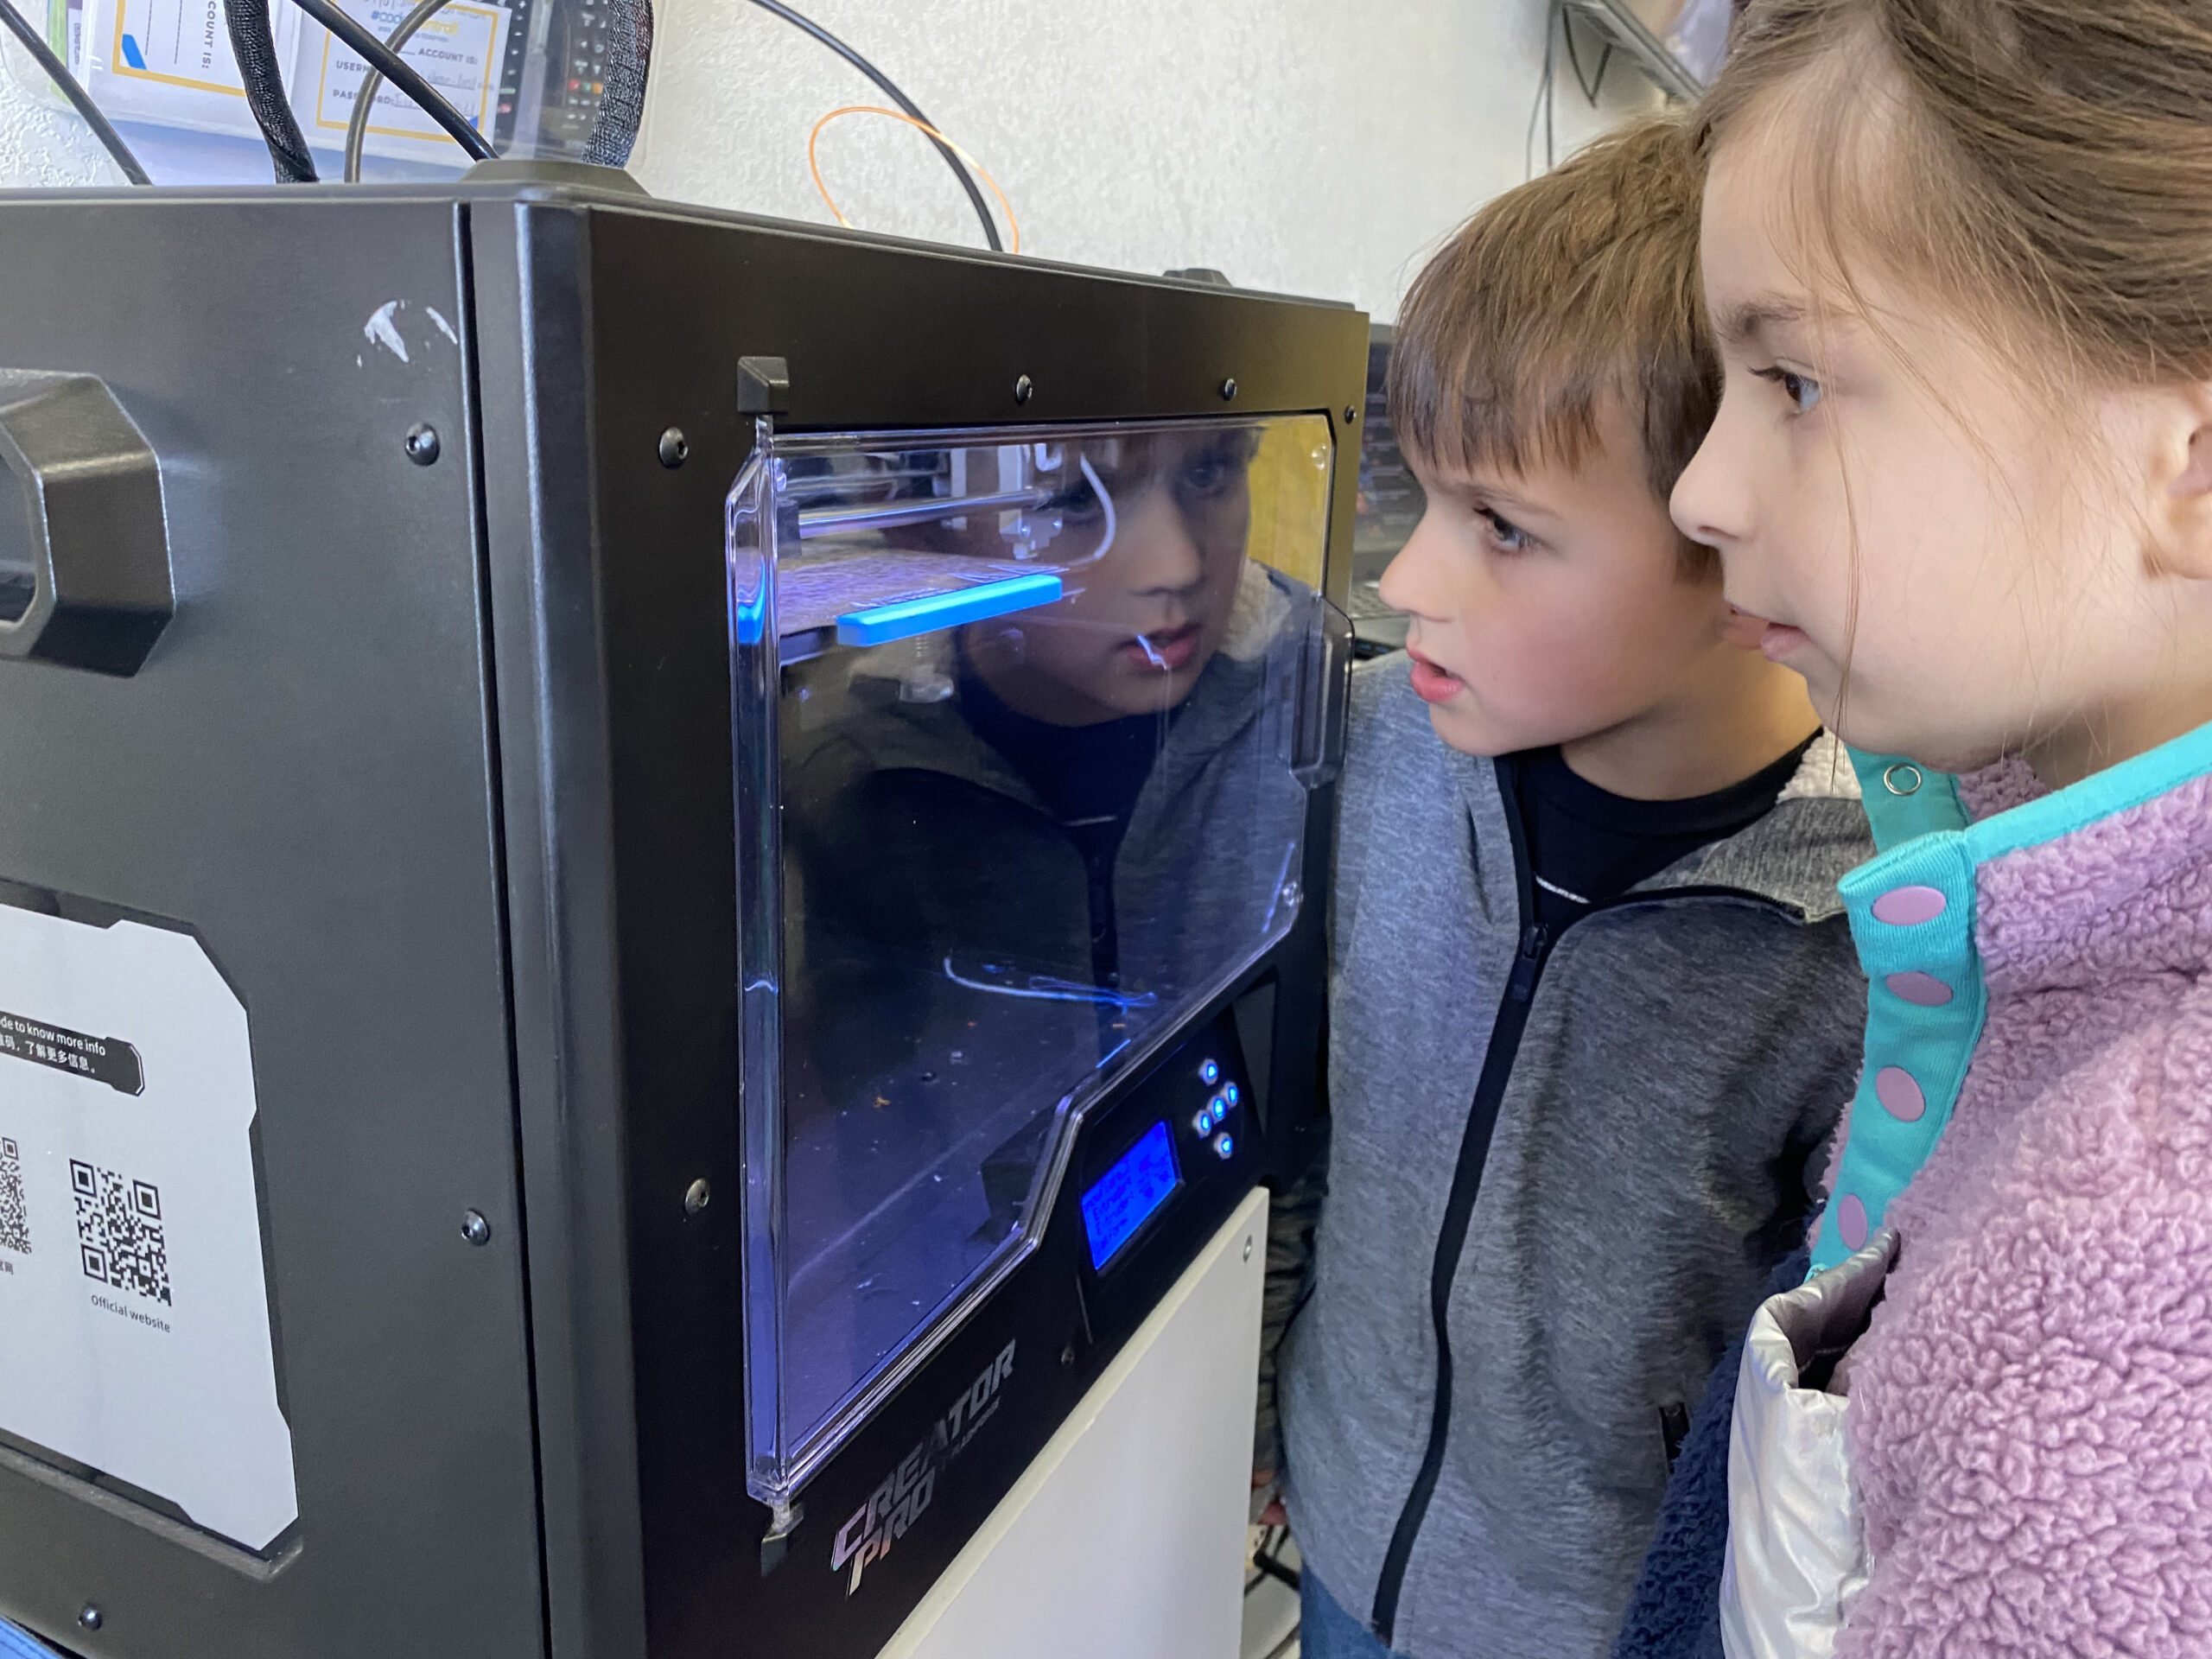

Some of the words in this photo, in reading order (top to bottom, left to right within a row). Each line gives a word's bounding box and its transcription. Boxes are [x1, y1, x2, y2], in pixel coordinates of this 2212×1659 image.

[203, 0, 216, 48] COUNT
[201, 52, 212, 69] IS:
[417, 48, 464, 62] ACCOUNT
[466, 56, 478, 65] IS:
[0, 1016, 14, 1030] de
[14, 1020, 25, 1033] to
[27, 1022, 54, 1041] know
[56, 1033, 84, 1049] more
[85, 1038, 105, 1056] info
[91, 1294, 128, 1318] Official
[129, 1310, 170, 1333] website
[830, 1338, 1016, 1572] CREATOR
[847, 1465, 936, 1598] PRO
